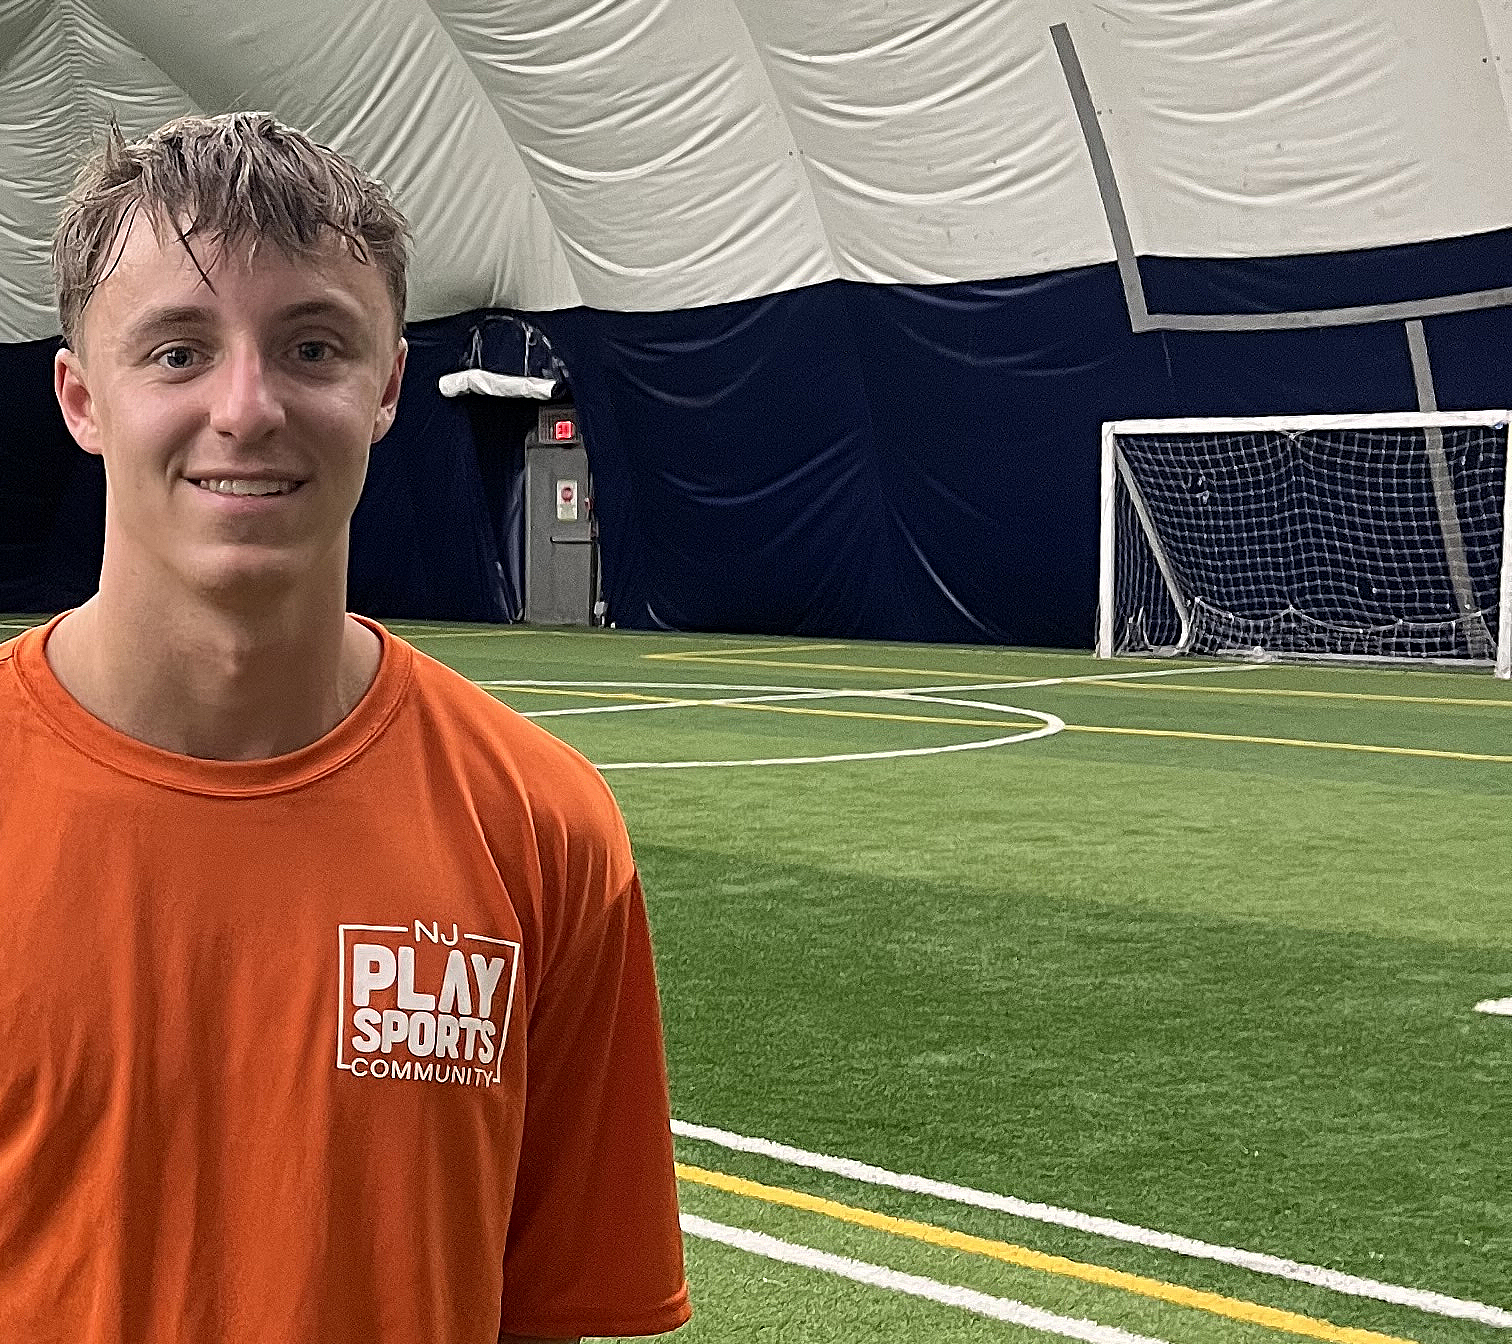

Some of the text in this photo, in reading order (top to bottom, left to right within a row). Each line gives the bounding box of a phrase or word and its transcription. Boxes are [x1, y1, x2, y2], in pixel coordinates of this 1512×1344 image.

[414, 919, 459, 946] NJ
[352, 943, 506, 1019] PLAY
[351, 1007, 497, 1064] SPORTS
[351, 1057, 494, 1088] COMMUNITY
